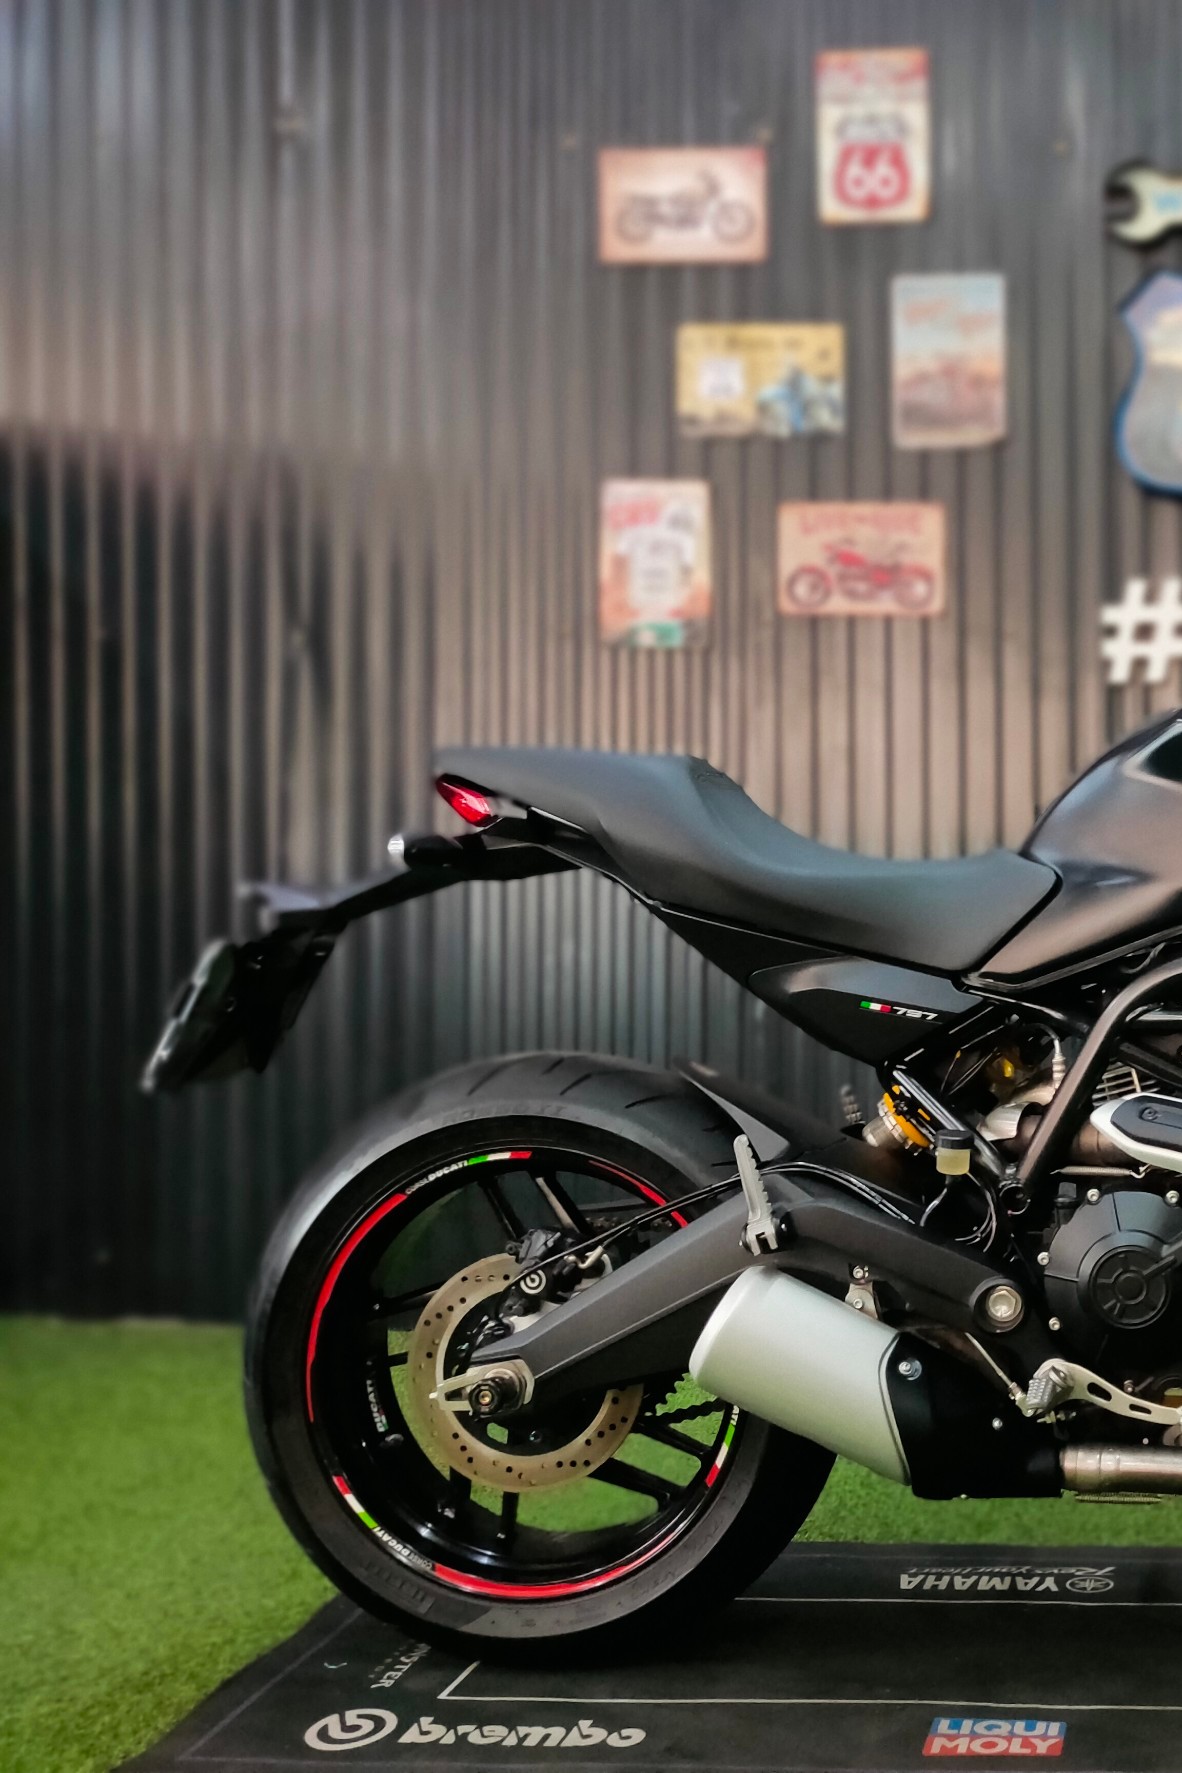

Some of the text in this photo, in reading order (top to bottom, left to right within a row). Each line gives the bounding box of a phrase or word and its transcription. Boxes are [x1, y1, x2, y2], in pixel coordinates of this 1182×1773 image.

[845, 142, 902, 200] 66
[893, 1006, 939, 1020] 797
[427, 1160, 468, 1182] DUCATI
[372, 1526, 411, 1556] DUCATI
[899, 1573, 1059, 1592] YAMAHA
[397, 1716, 647, 1748] brembo
[937, 1719, 1061, 1736] LIQUI
[930, 1737, 1061, 1754] MOLY
